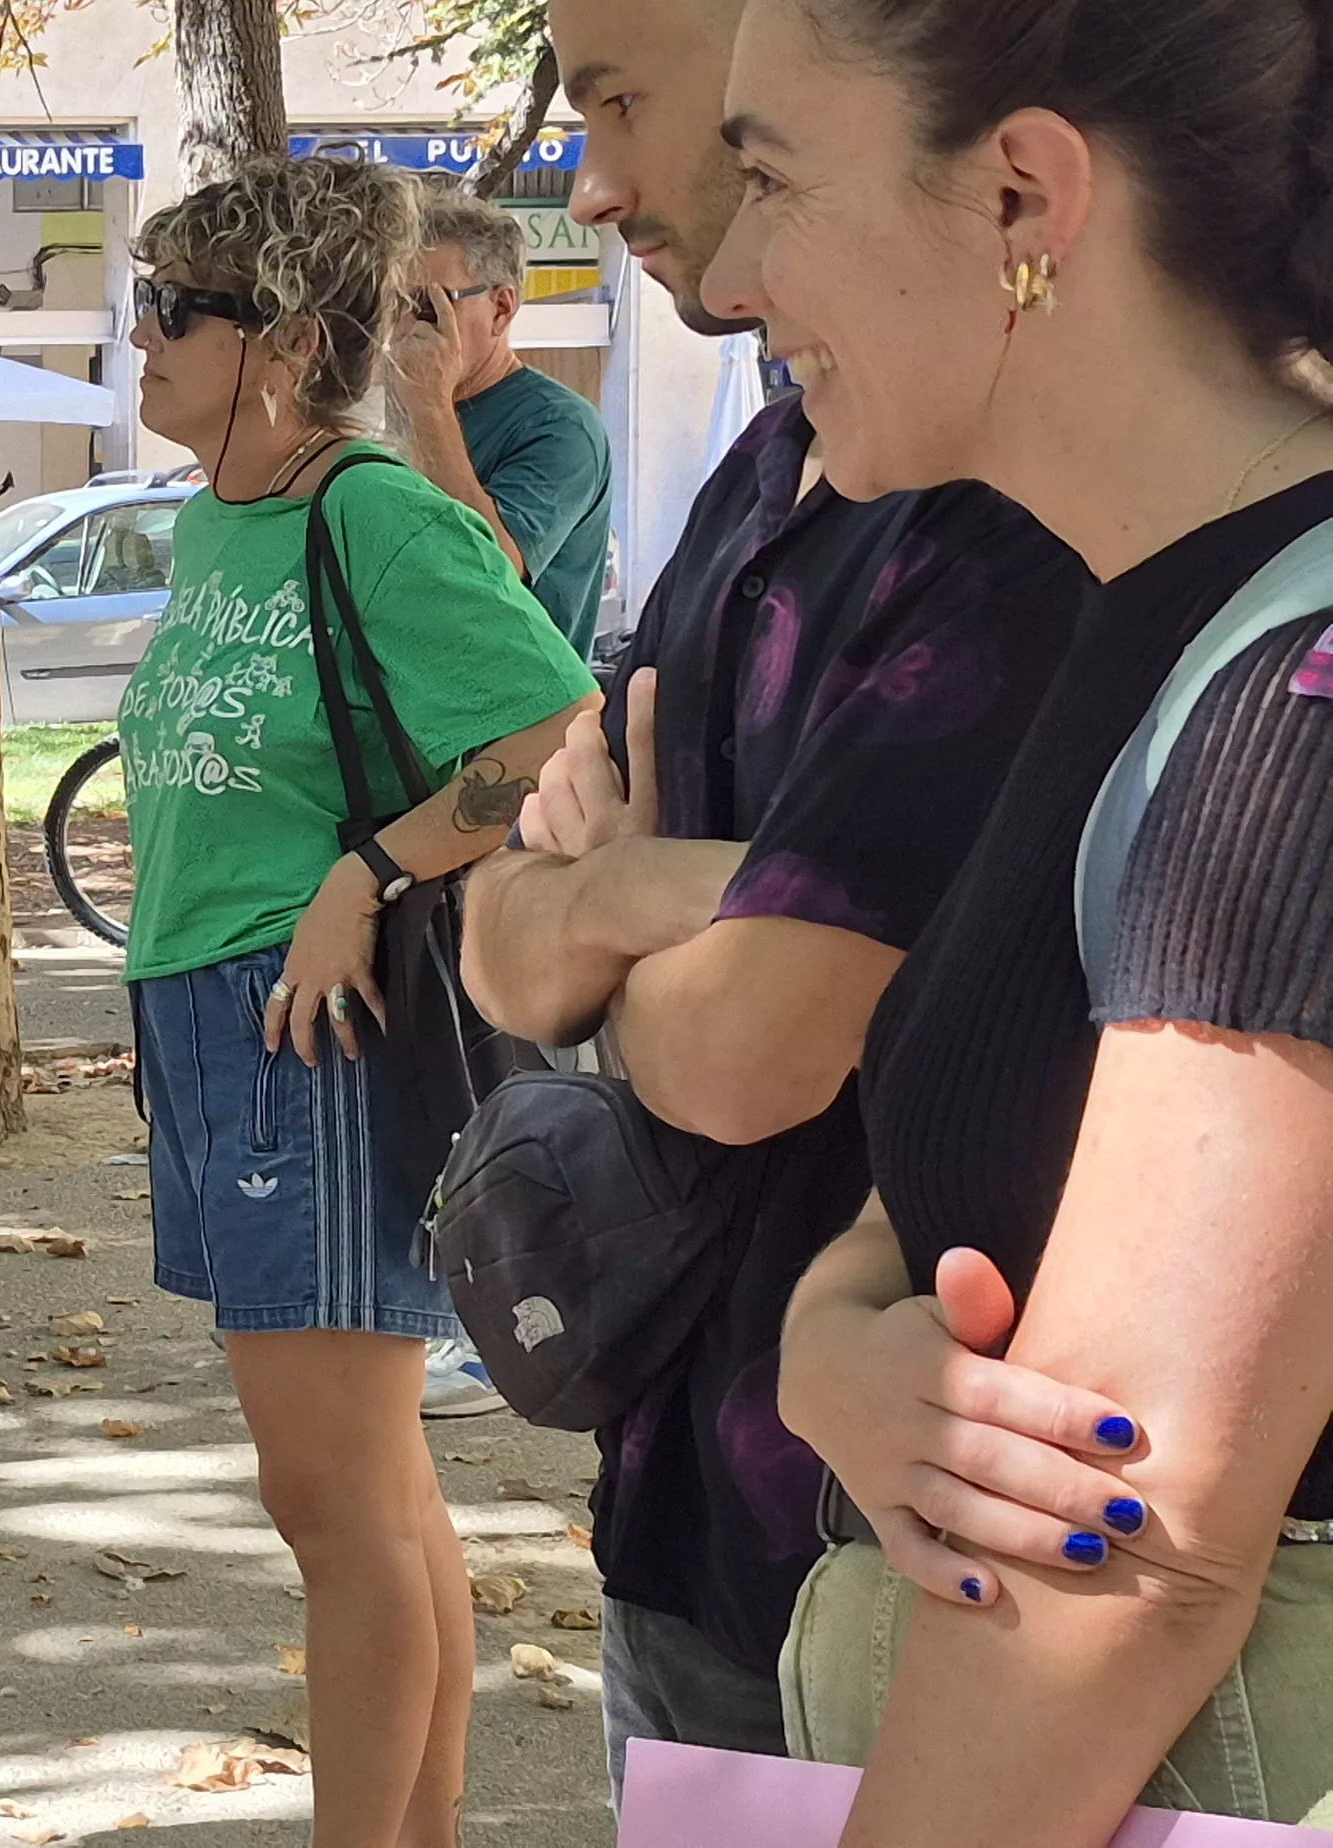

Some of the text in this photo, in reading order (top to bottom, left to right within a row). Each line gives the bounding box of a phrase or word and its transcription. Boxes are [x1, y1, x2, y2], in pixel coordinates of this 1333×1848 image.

[202, 584, 332, 656] PÚBLICA
[121, 675, 253, 720] DE TOD@S
[126, 748, 263, 795] ARA TOD@S
